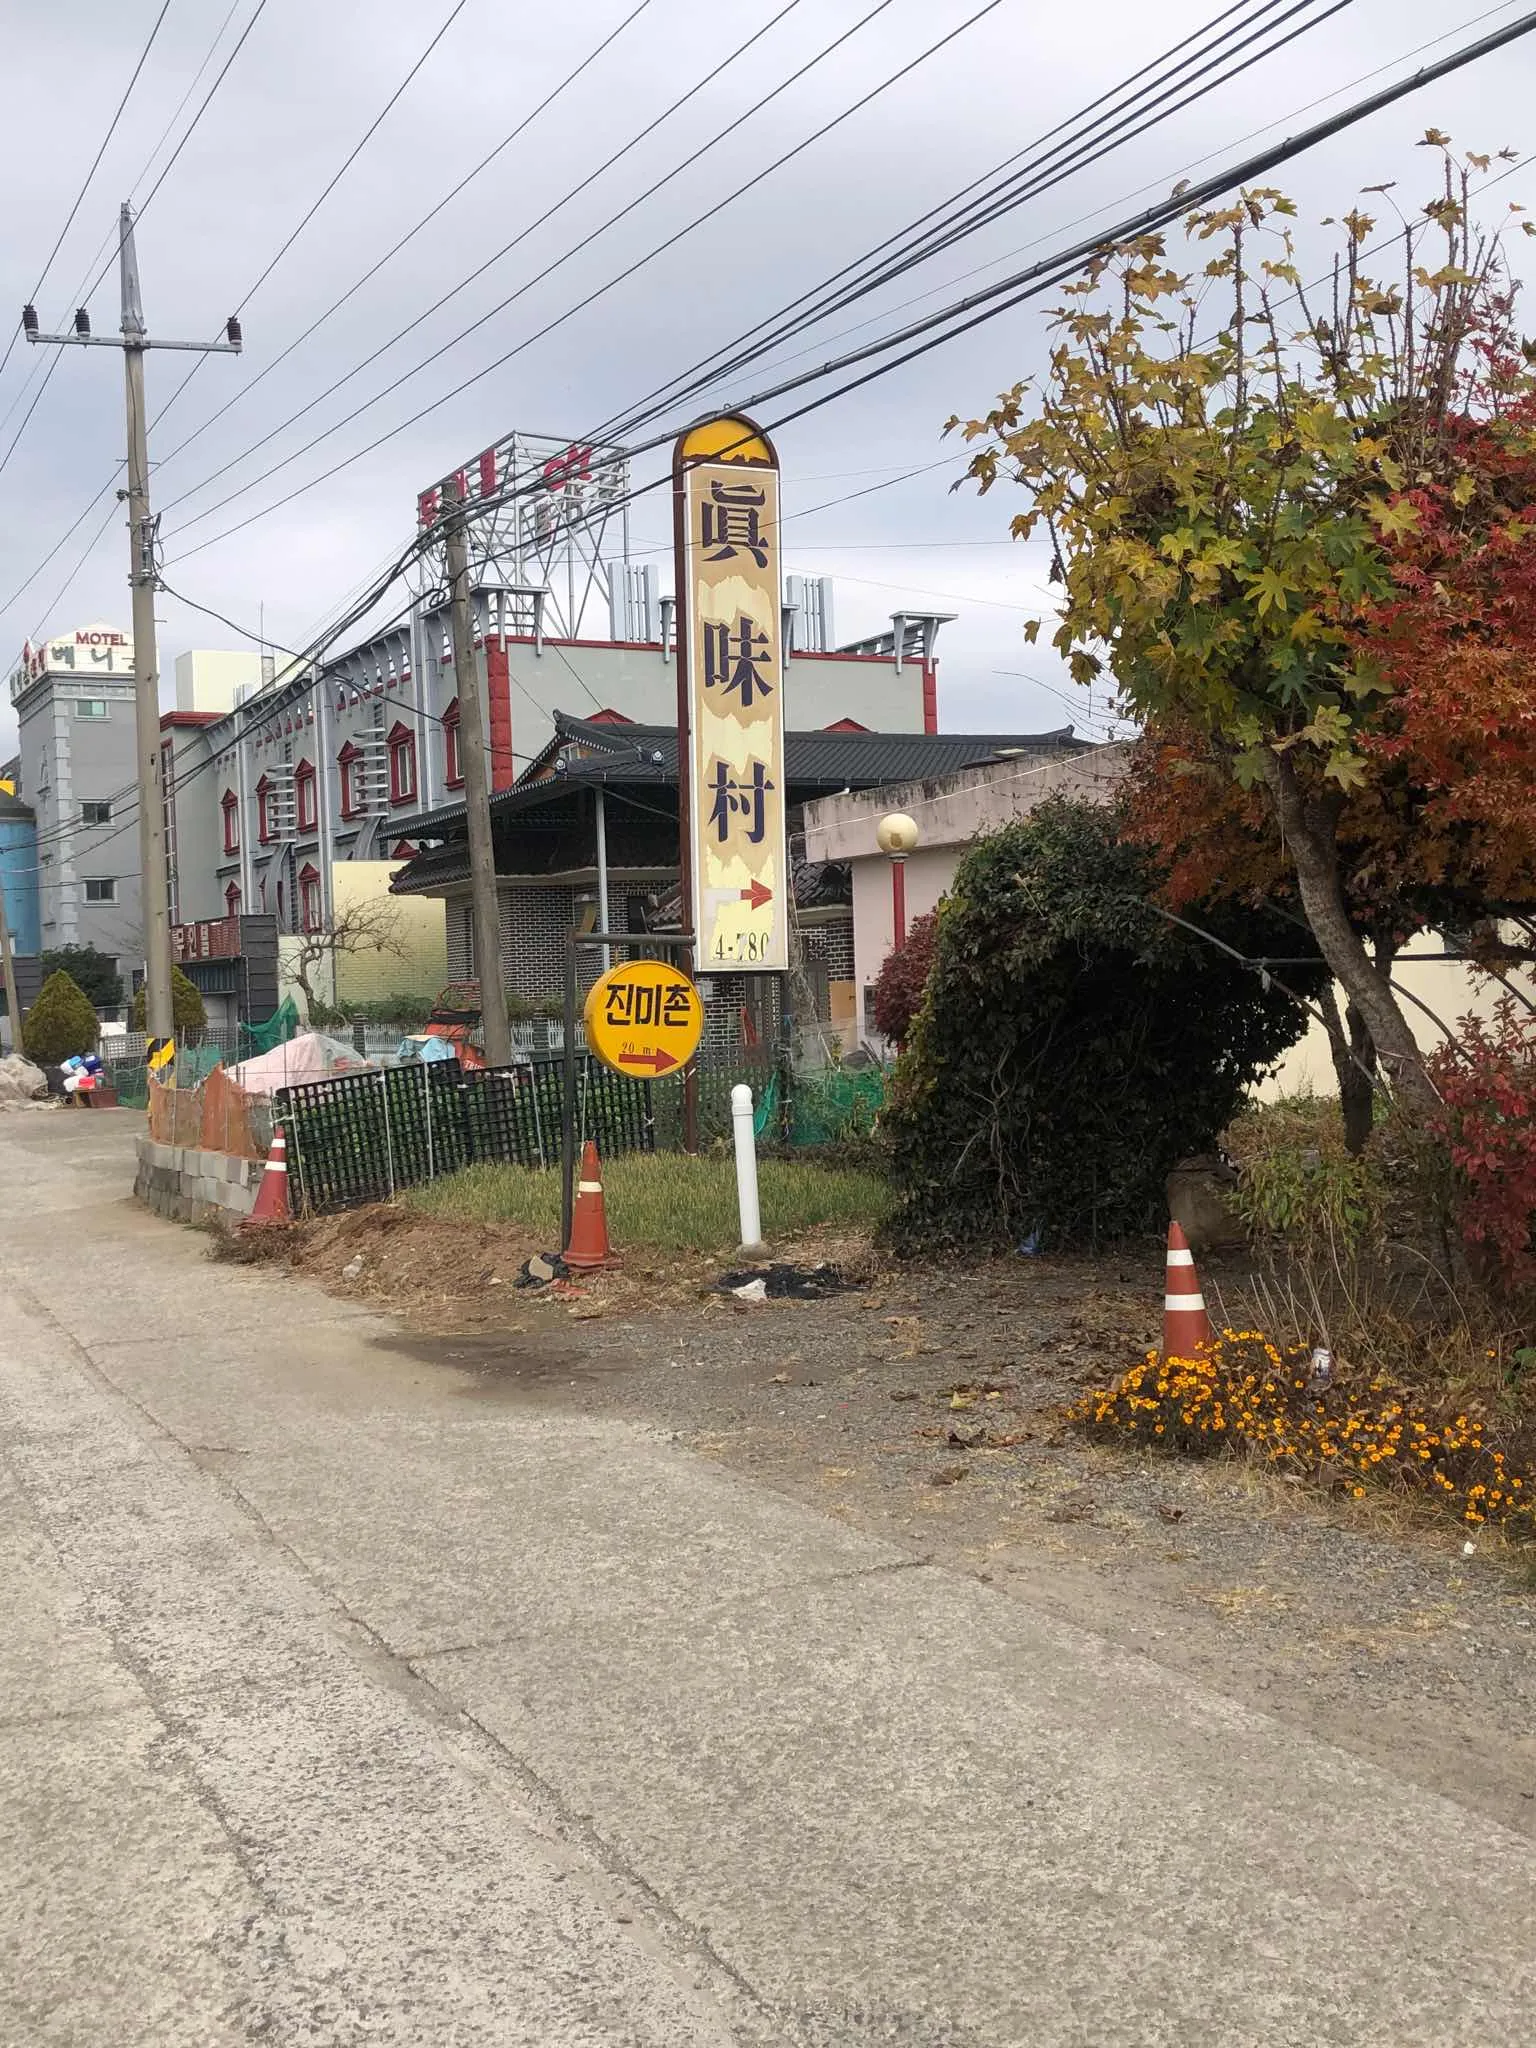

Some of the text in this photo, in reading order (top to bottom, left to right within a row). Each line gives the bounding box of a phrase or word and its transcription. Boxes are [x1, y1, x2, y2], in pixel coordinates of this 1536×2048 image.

[76, 632, 128, 646] MOTEL
[701, 479, 774, 844] 眞味村
[605, 983, 691, 1027] 진미촌
[621, 1041, 635, 1054] 20
